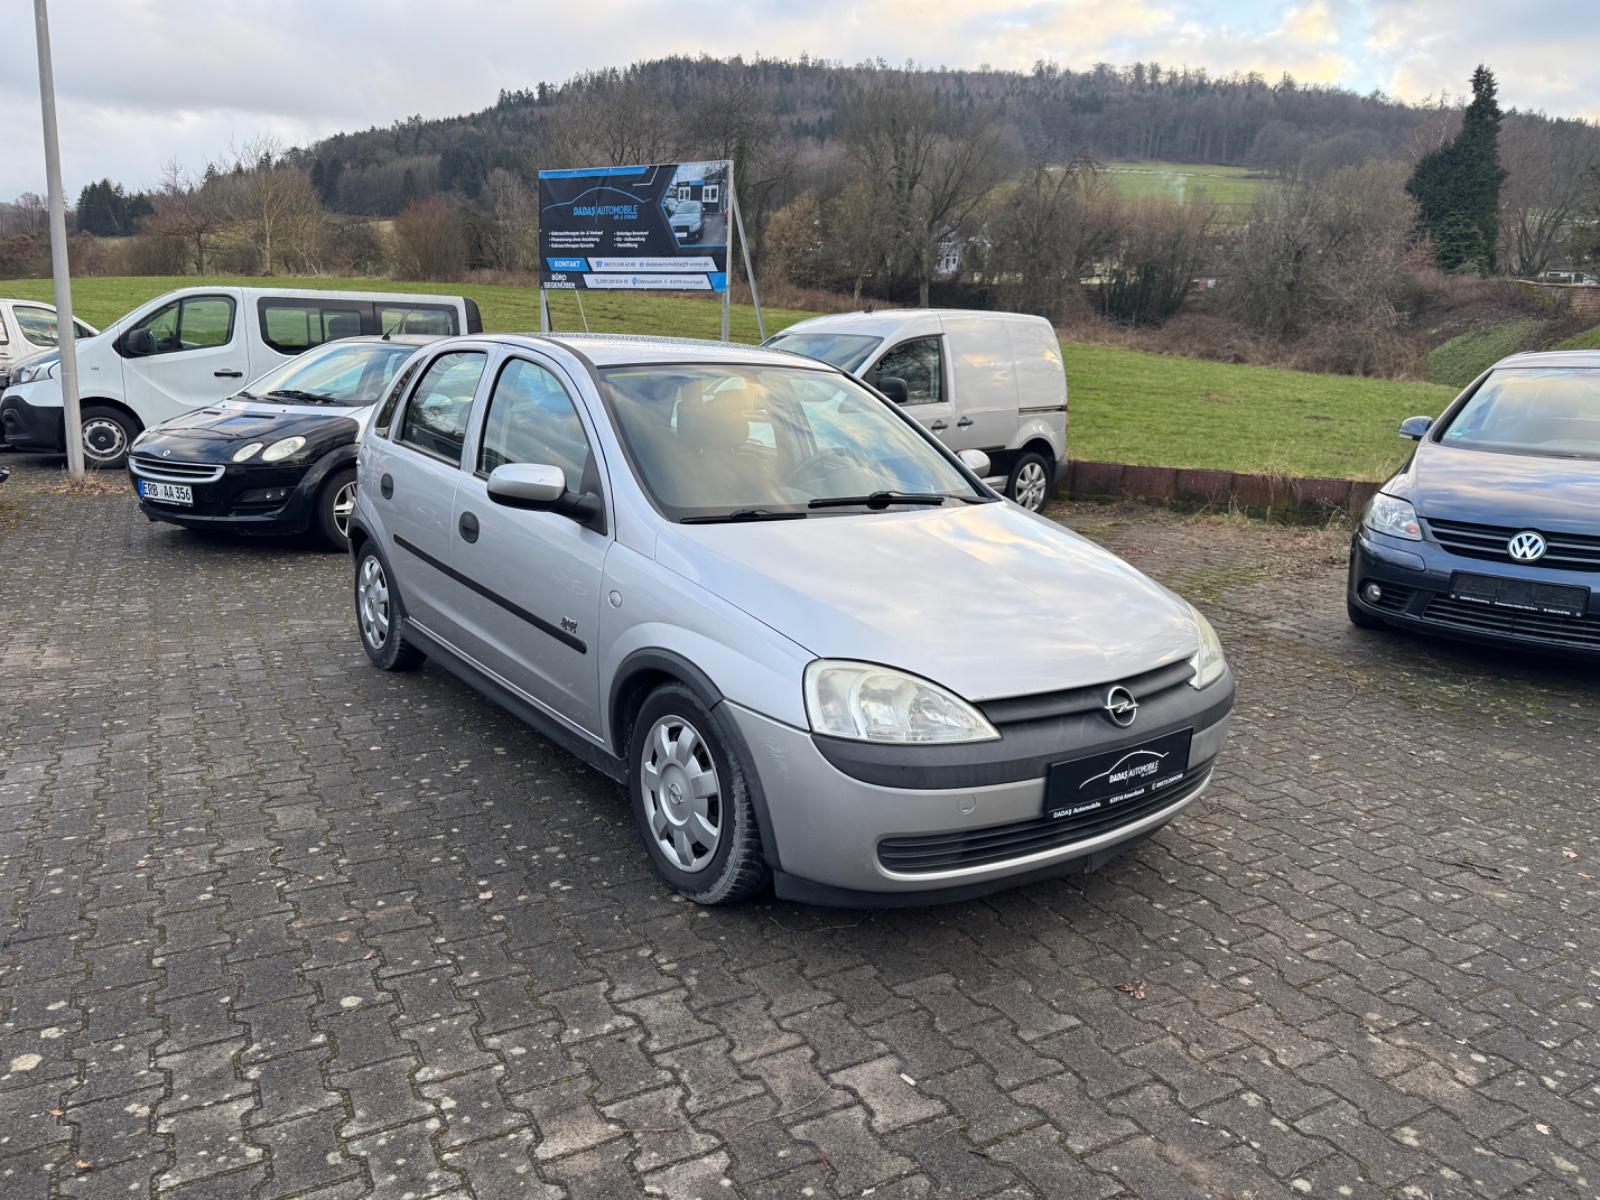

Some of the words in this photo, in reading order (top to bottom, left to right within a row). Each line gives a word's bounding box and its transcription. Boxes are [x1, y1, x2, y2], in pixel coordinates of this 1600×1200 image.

[597, 204, 639, 216] AUTOMOBILE
[554, 260, 581, 268] KONTAKT
[551, 272, 568, 281] BÜRO
[543, 280, 576, 289] GEGENÜBER
[143, 482, 159, 496] ERB
[164, 485, 174, 499] AA
[174, 486, 191, 501] 356
[1128, 760, 1159, 778] AUTOMOBILE
[1073, 801, 1101, 814] Automobile
